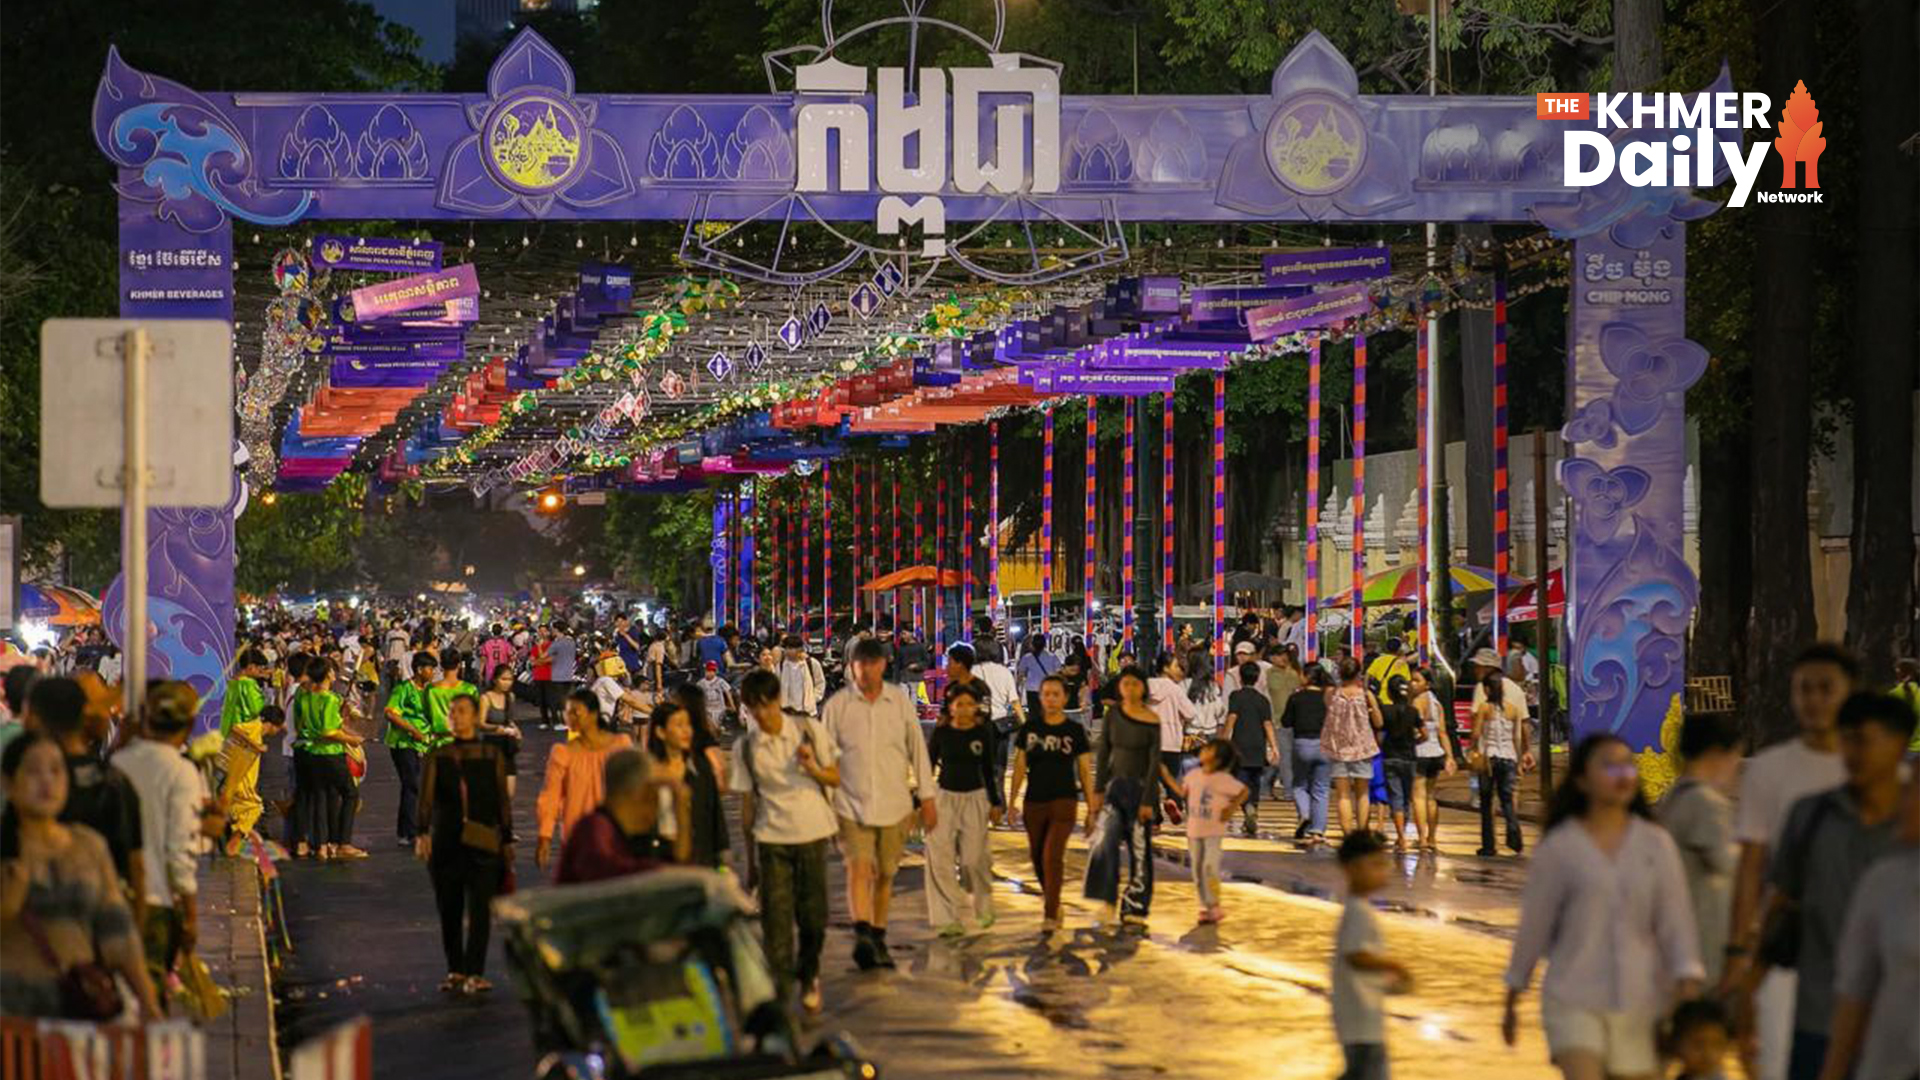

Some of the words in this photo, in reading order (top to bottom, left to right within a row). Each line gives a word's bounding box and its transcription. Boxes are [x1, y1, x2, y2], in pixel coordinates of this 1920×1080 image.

[130, 289, 165, 300] KHMER
[166, 289, 224, 300] BEVERAGES
[1586, 291, 1621, 303] CHIP
[1623, 290, 1671, 303] MONG
